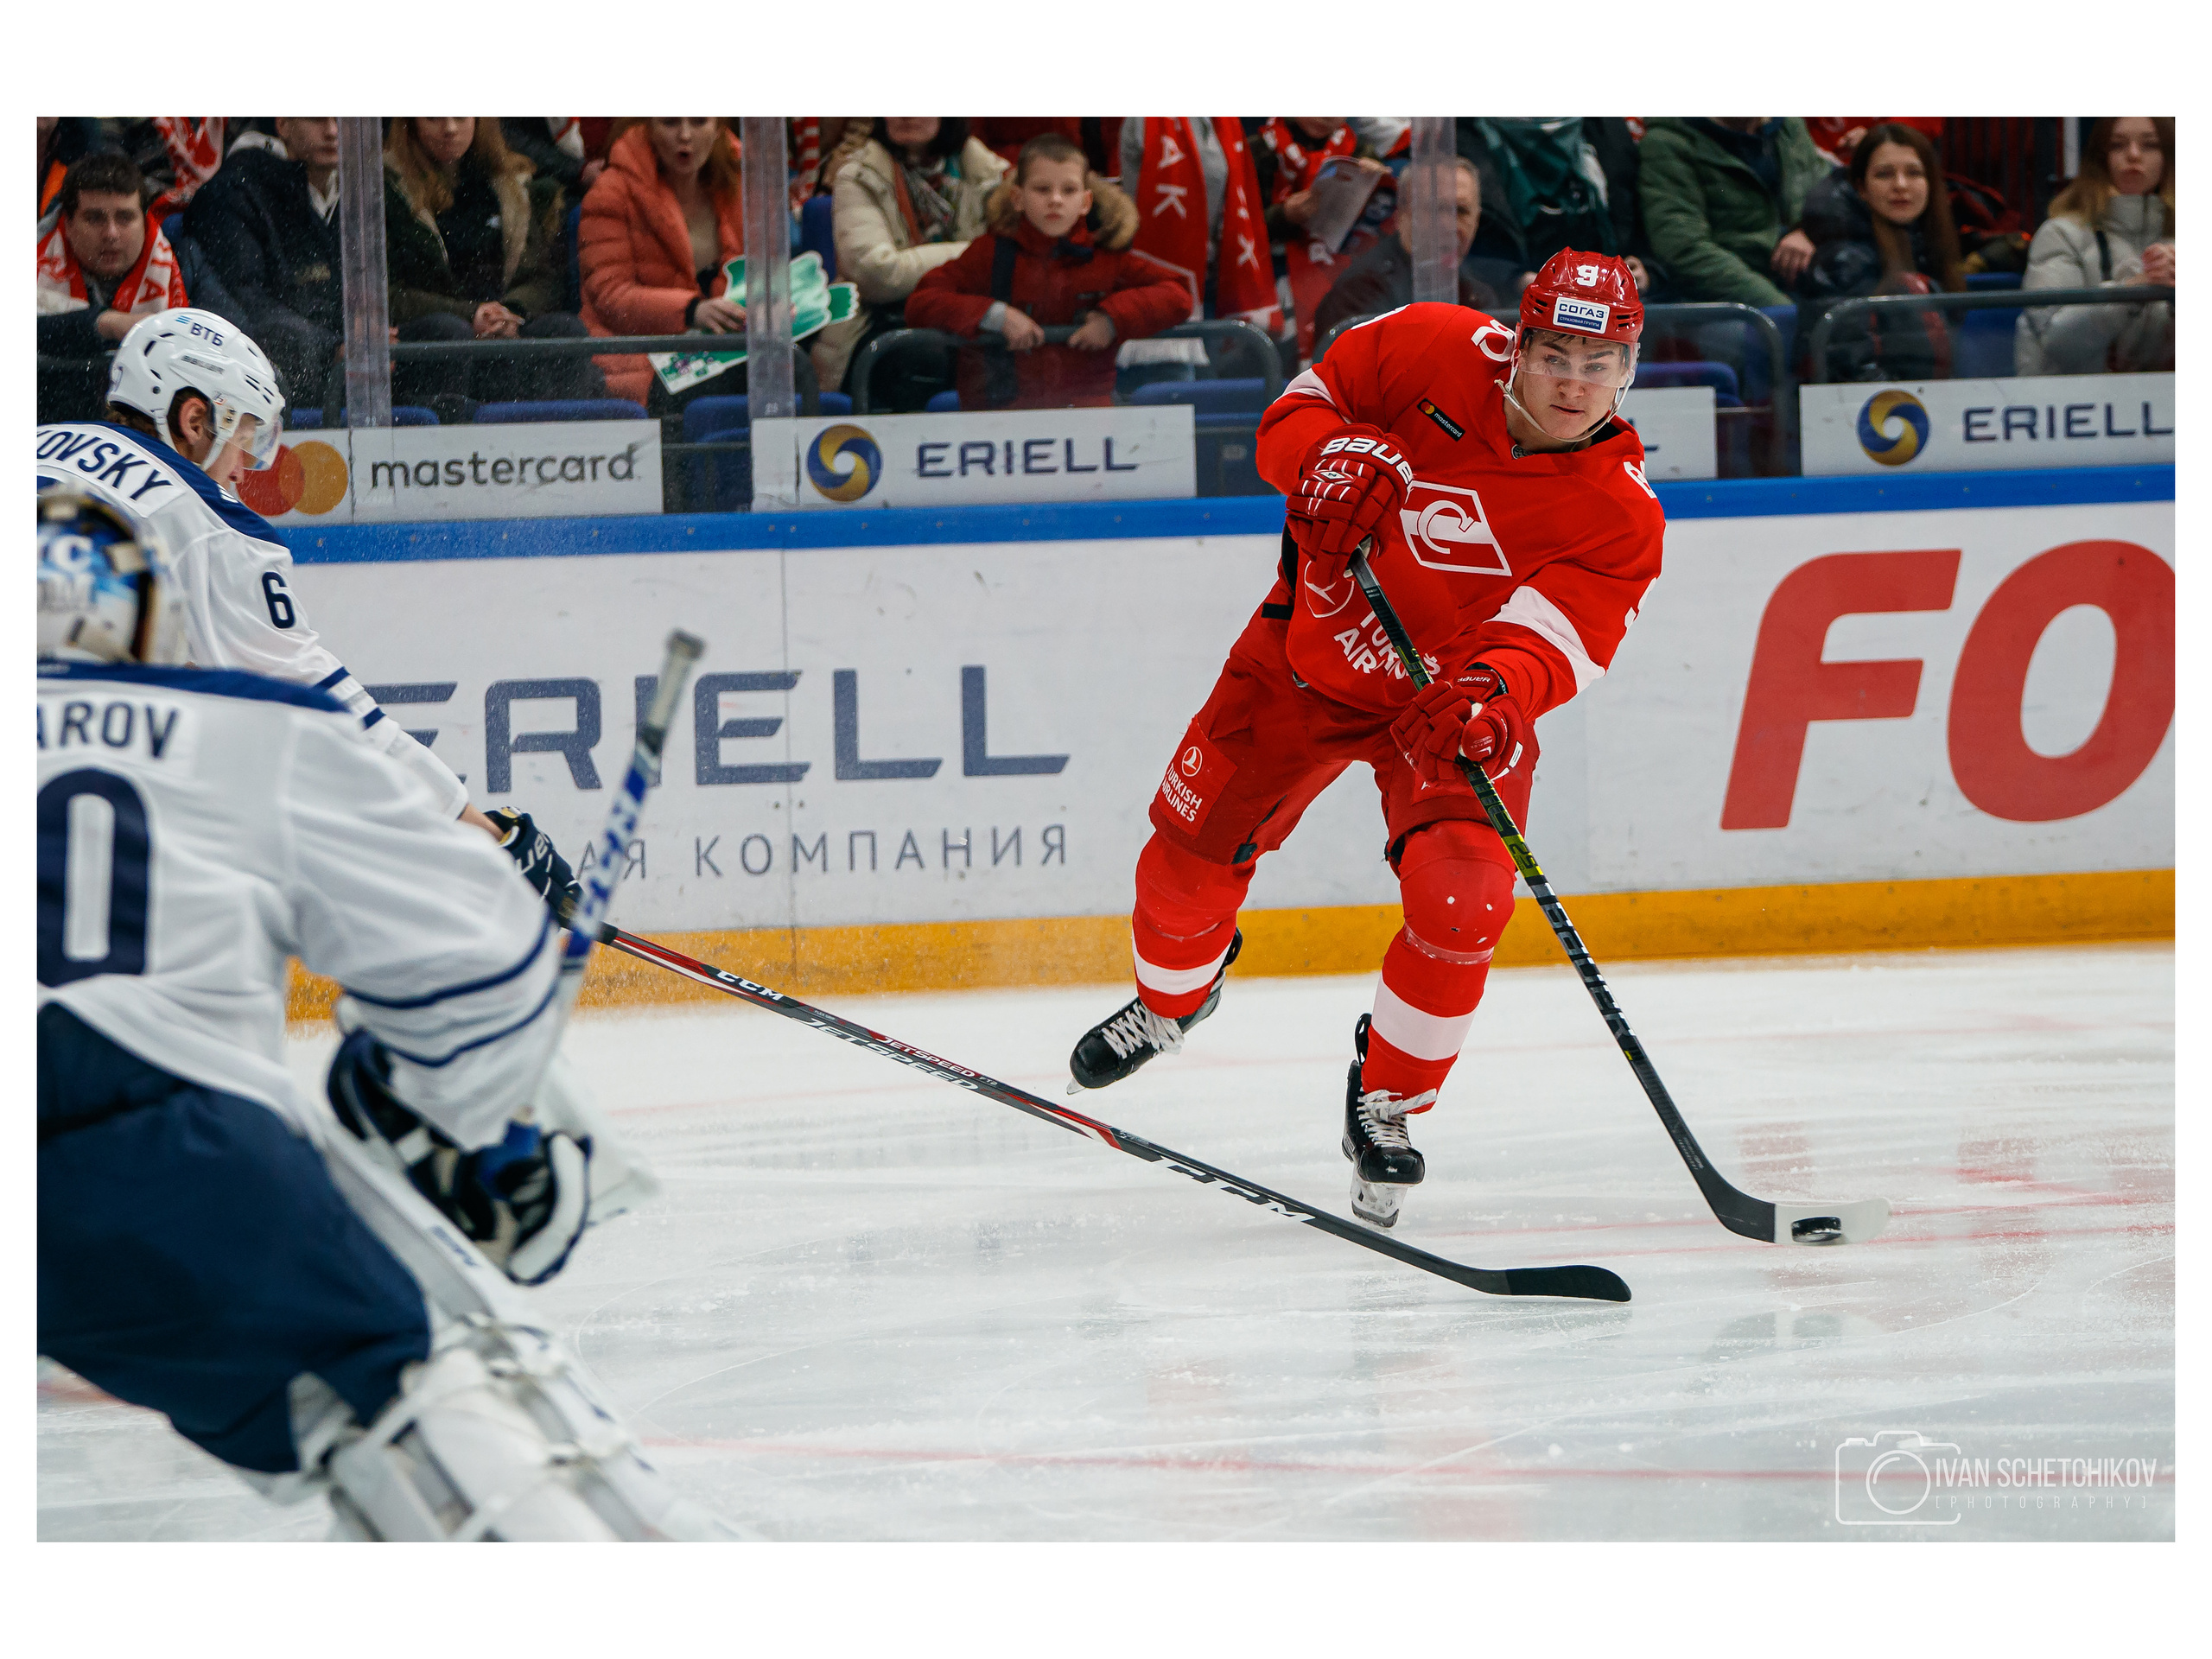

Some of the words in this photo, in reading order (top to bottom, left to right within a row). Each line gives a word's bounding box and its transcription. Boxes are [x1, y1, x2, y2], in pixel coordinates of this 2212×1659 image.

[1575, 264, 1599, 287] 9
[1559, 303, 1605, 319] СОГАЗ
[190, 321, 226, 346] ВТБ
[1433, 412, 1463, 438] mastercard
[1962, 401, 2175, 443] ERIELL
[37, 430, 174, 501] OVSKY
[371, 442, 635, 489] mastercard
[917, 435, 1140, 478] ERIELL
[262, 571, 296, 630] 6
[1719, 538, 2176, 832] FO
[1161, 777, 1198, 823] AIRLINES
[1166, 761, 1203, 810] TURKISH
[695, 823, 1068, 879] КОМПАНИЯ
[715, 969, 785, 1001] CCM
[794, 1017, 979, 1090] JETSPEED
[874, 1035, 976, 1077] JETSPEED
